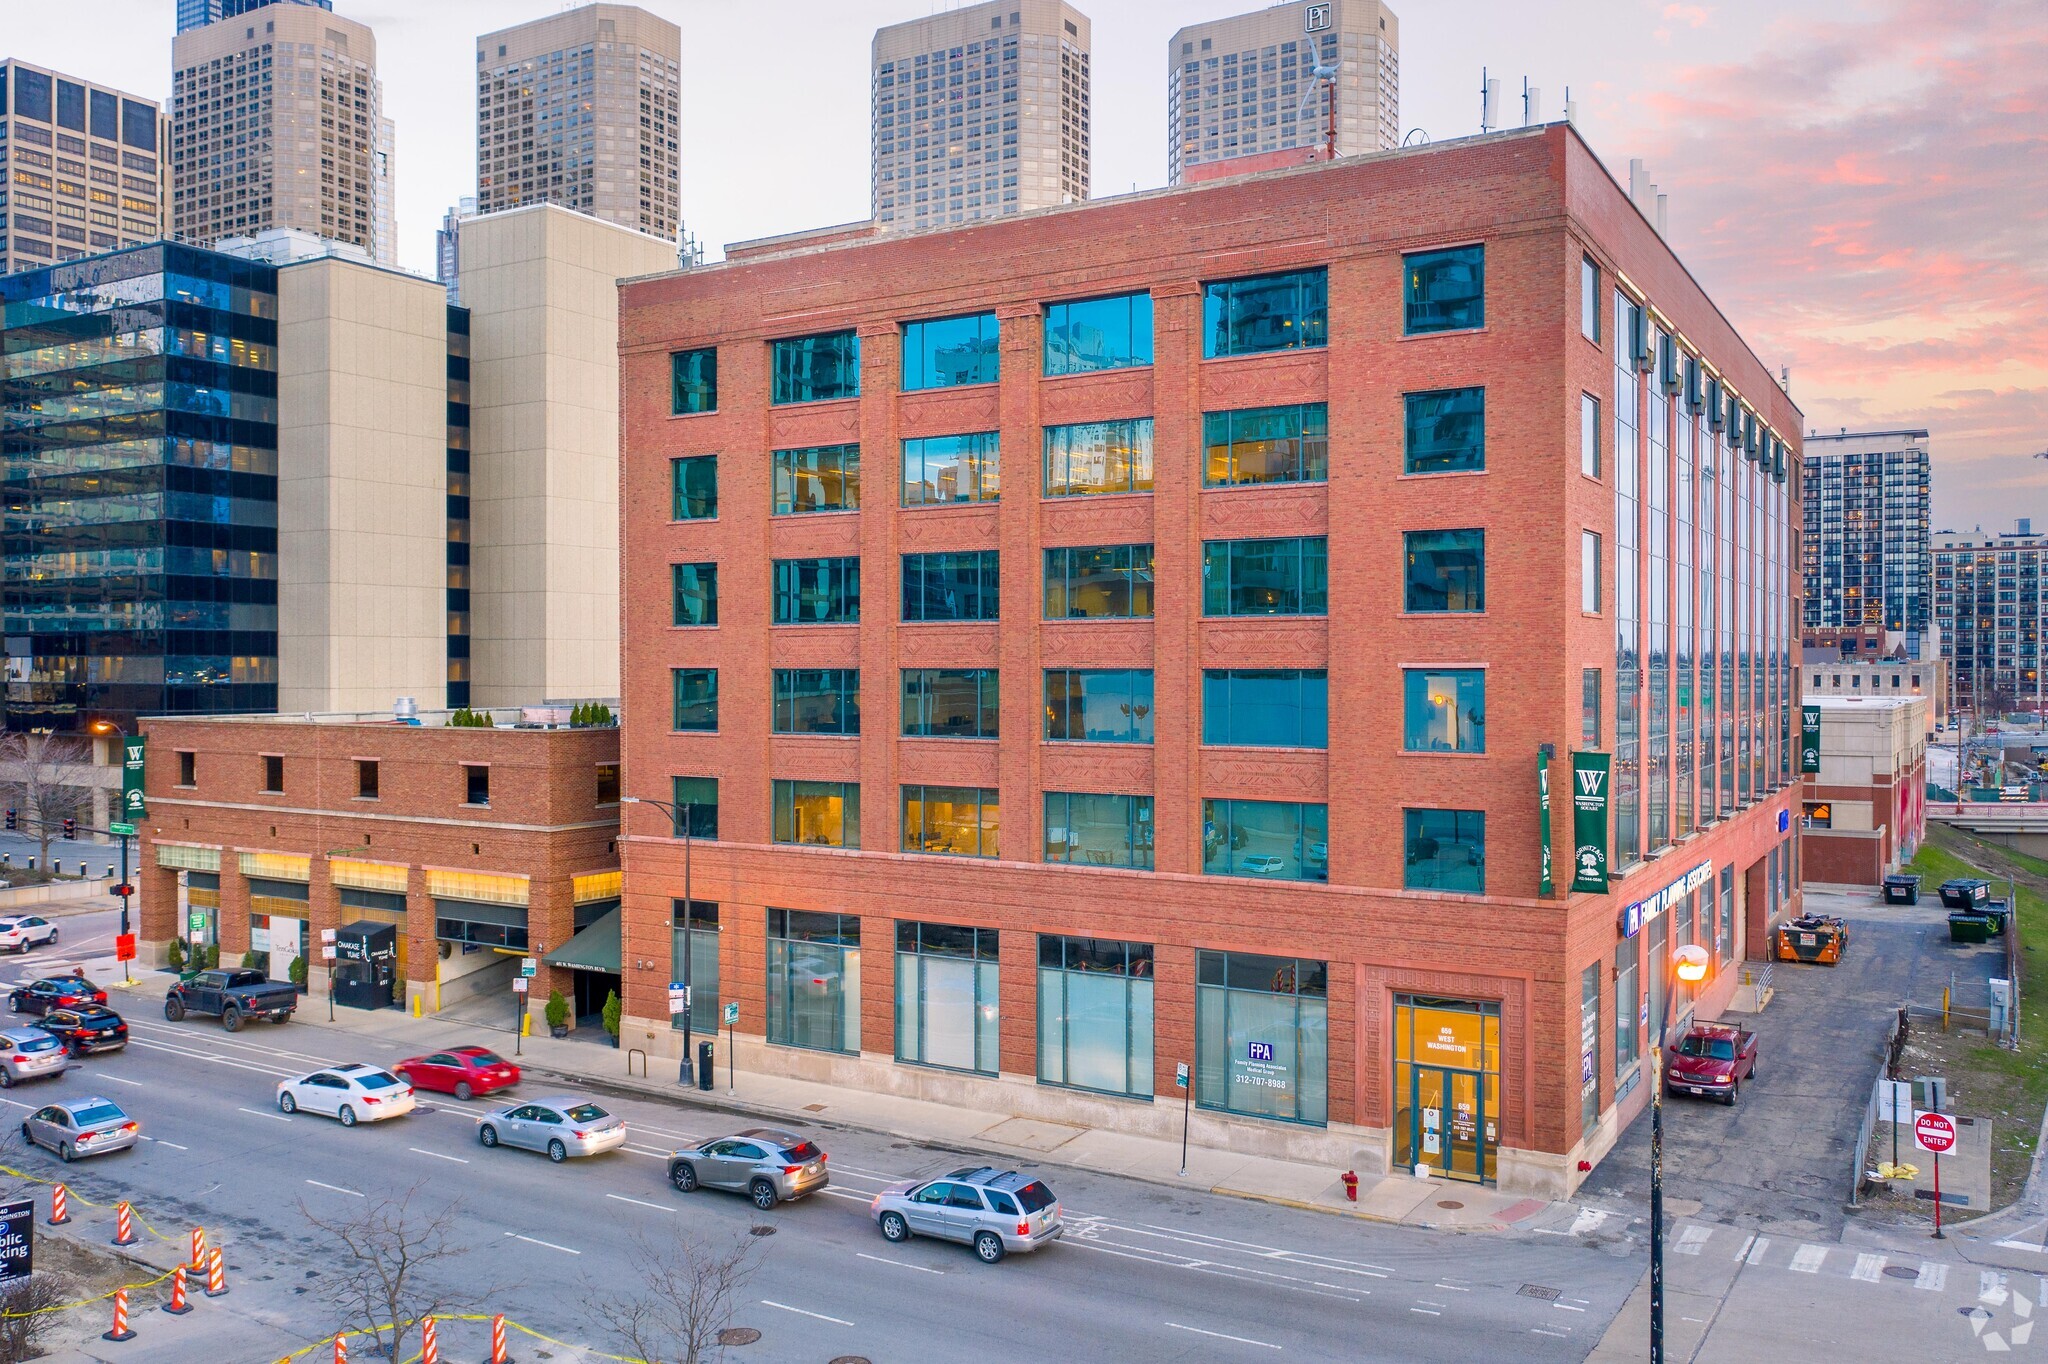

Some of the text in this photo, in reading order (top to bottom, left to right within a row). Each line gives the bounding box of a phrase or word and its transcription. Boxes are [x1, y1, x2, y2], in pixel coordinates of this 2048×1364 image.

[127, 745, 144, 761] W
[1575, 769, 1606, 795] W
[1438, 1034, 1455, 1043] WEST
[1250, 1043, 1271, 1060] FPA
[1427, 1041, 1467, 1053] WASHINGTON
[1235, 1074, 1287, 1089] 312-707-8988
[1920, 1119, 1949, 1130] DO NOT
[1923, 1136, 1948, 1147] ENTER
